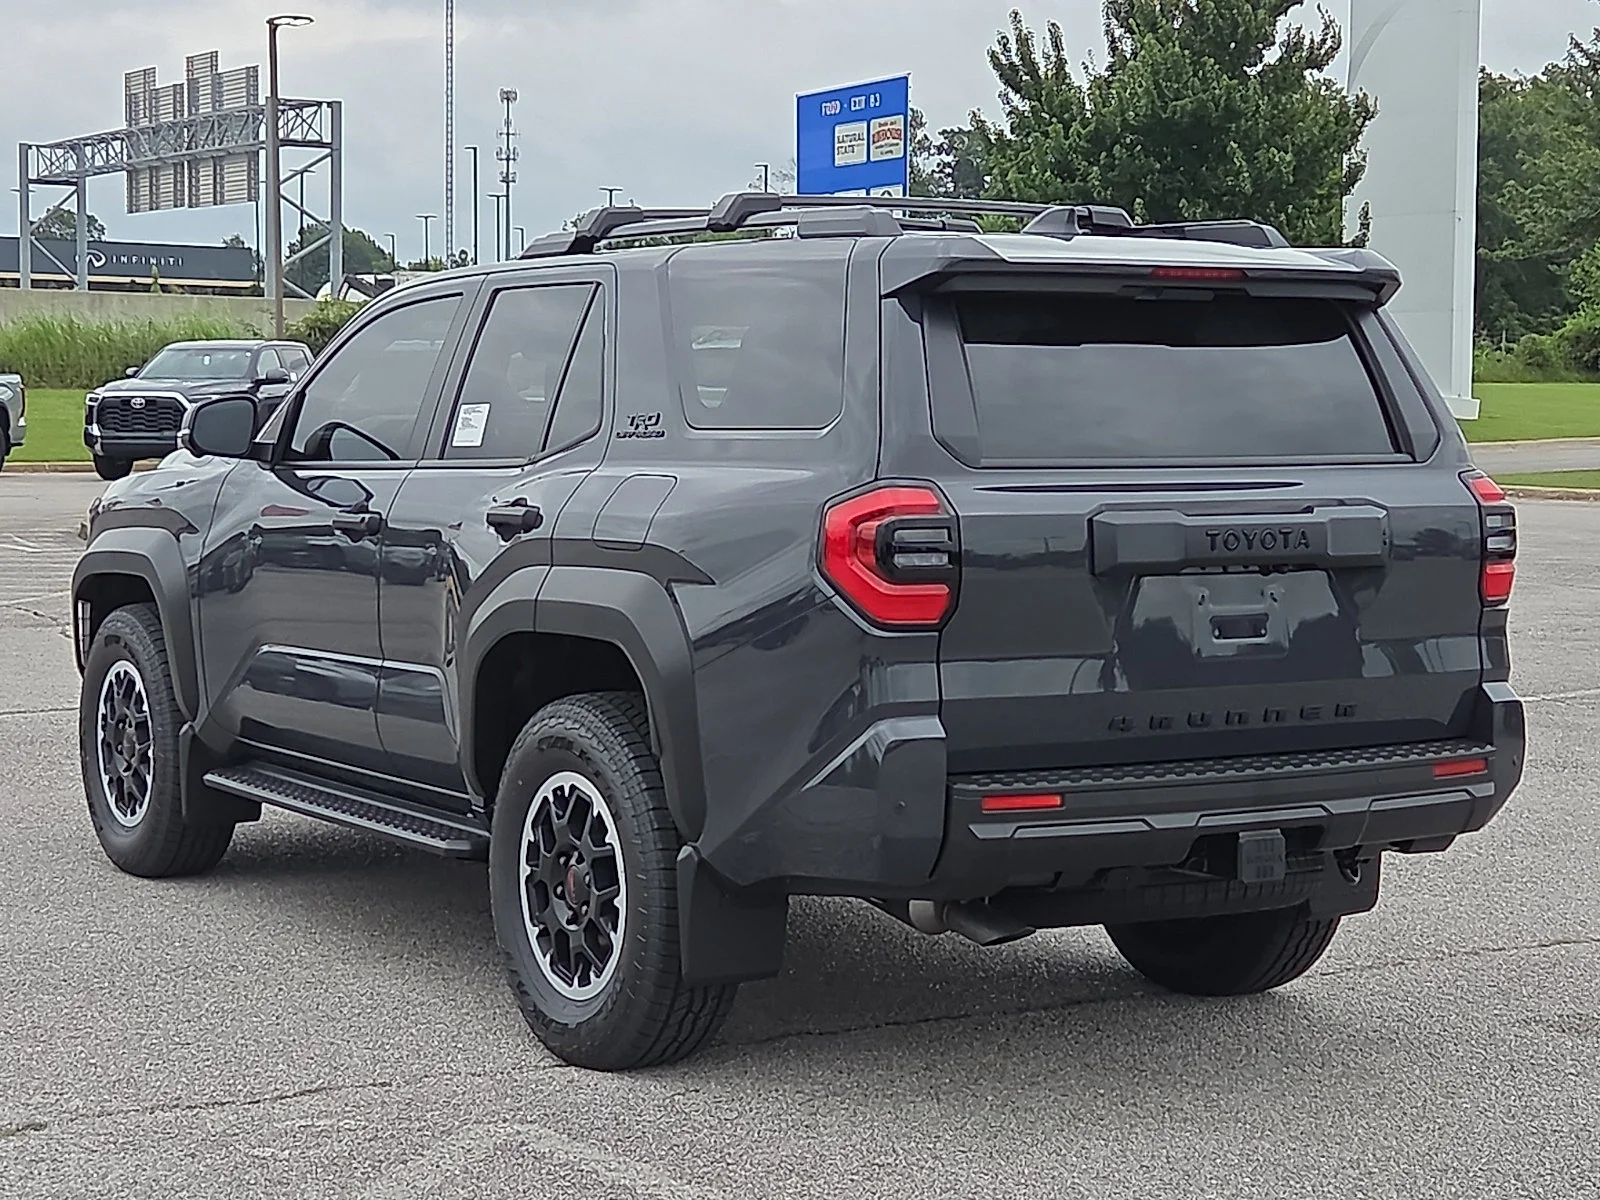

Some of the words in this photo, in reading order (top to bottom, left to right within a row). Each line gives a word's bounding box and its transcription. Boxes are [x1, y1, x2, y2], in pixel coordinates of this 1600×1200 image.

[836, 132, 865, 145] NATURAL
[836, 144, 856, 156] STATE
[112, 254, 183, 266] INFINITI
[627, 411, 661, 431] TRD
[1205, 527, 1310, 552] TOYOTA
